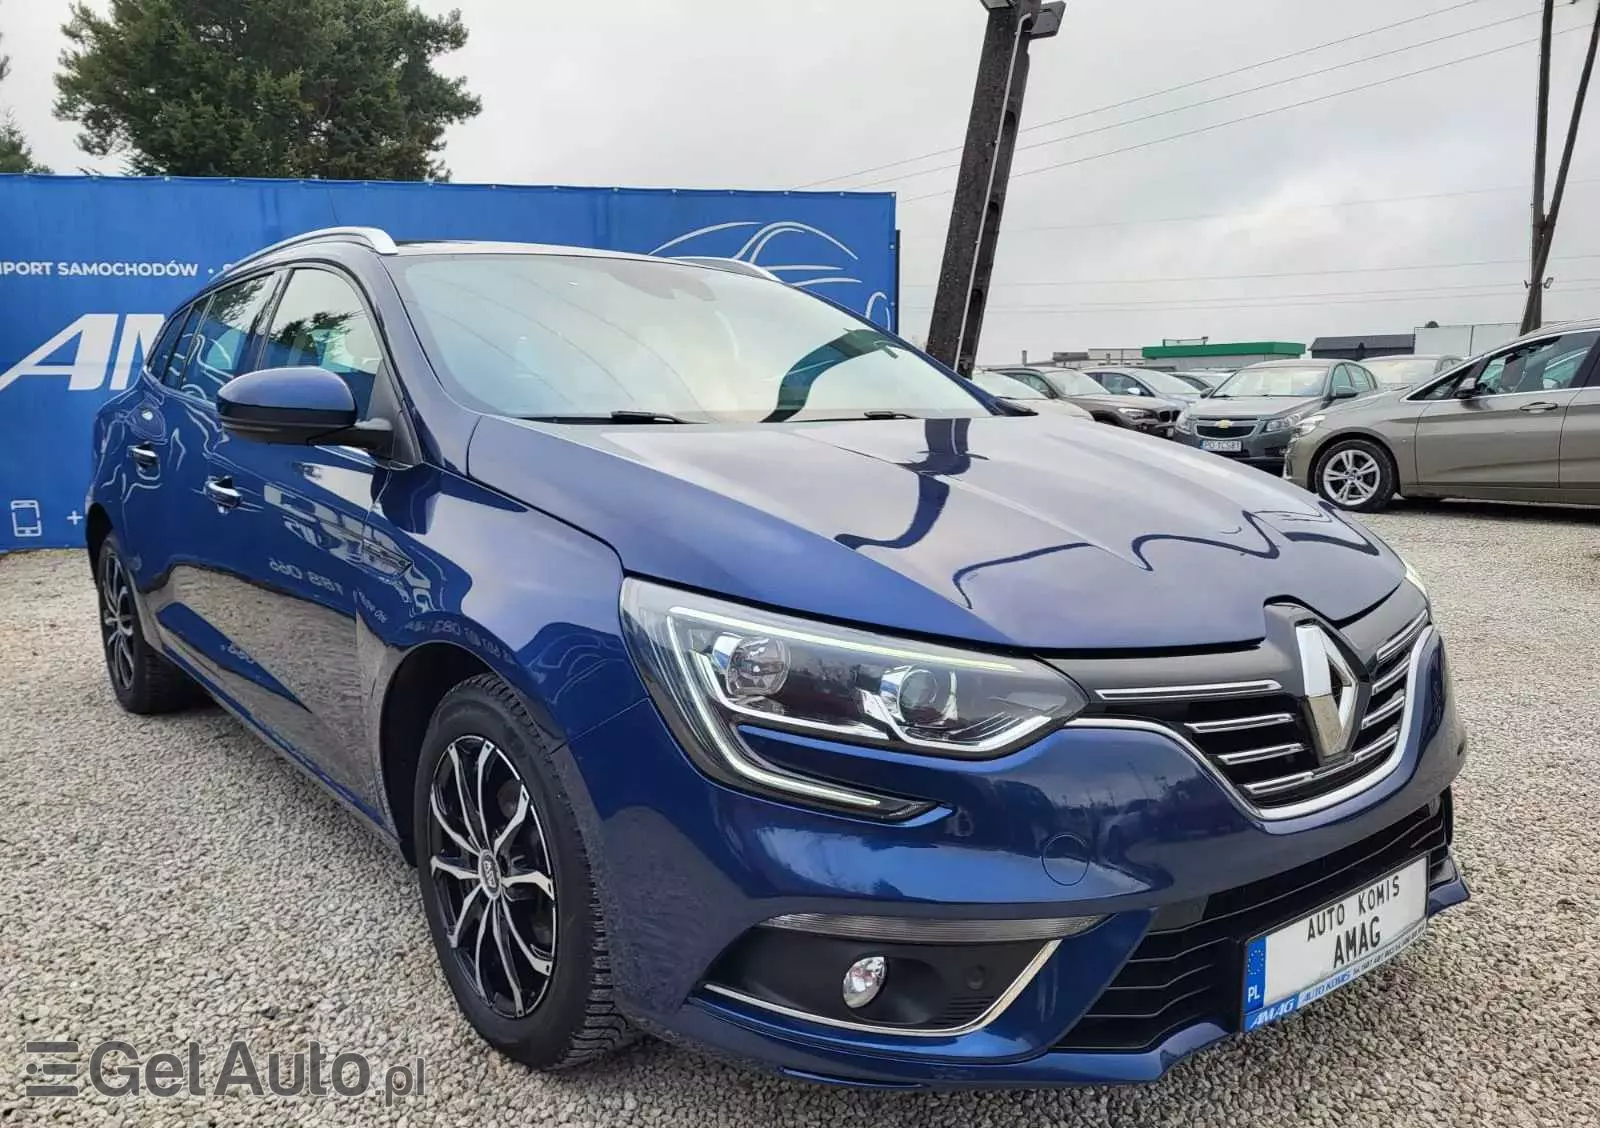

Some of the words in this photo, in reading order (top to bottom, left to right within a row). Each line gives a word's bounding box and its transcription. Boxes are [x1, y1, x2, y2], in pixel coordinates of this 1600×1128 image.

[0, 261, 54, 276] PORT
[57, 260, 198, 277] SAMOCHODÓW
[1307, 904, 1345, 942] AUTO
[1358, 875, 1400, 916] KOMIS
[1333, 916, 1381, 969] AMAG
[1247, 984, 1261, 1003] PL
[1250, 998, 1294, 1029] AMAG
